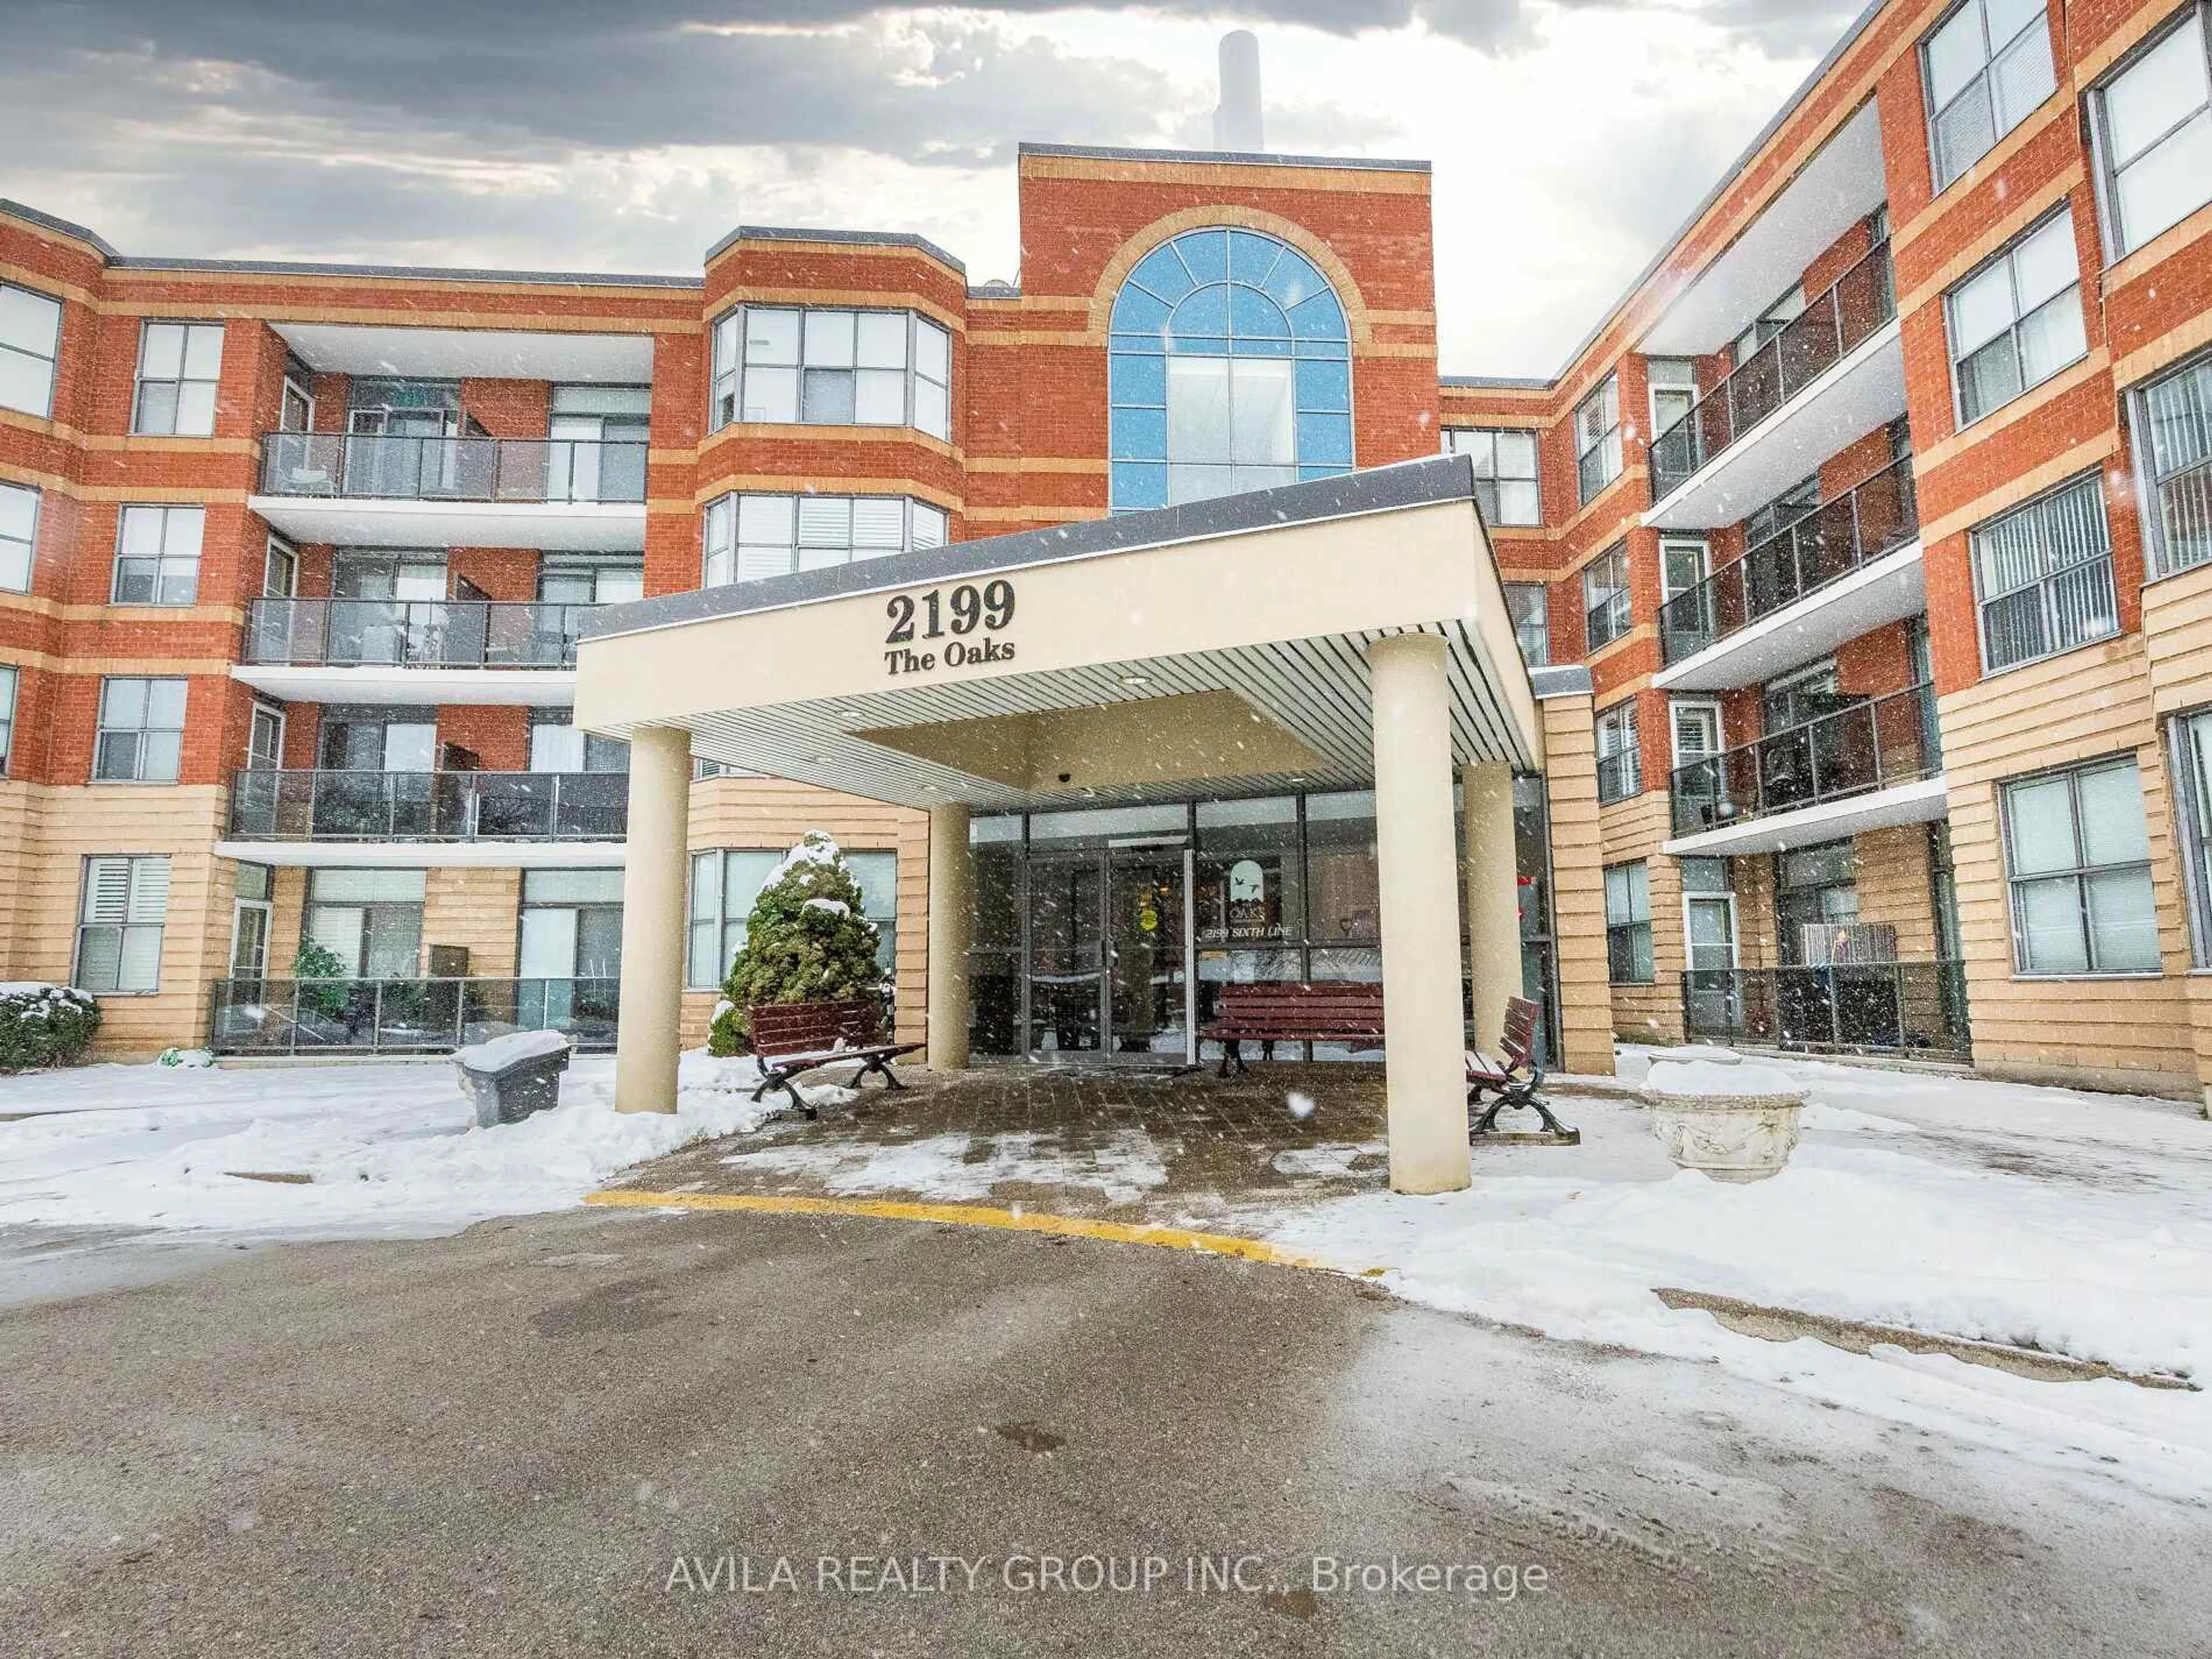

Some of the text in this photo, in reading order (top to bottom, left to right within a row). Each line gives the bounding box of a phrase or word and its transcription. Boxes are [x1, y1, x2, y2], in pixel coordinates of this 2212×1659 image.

[885, 579, 1016, 644] 2199
[885, 637, 1016, 675] The Oaks
[1232, 927, 1265, 938] SIXTH
[1267, 926, 1295, 937] LINE
